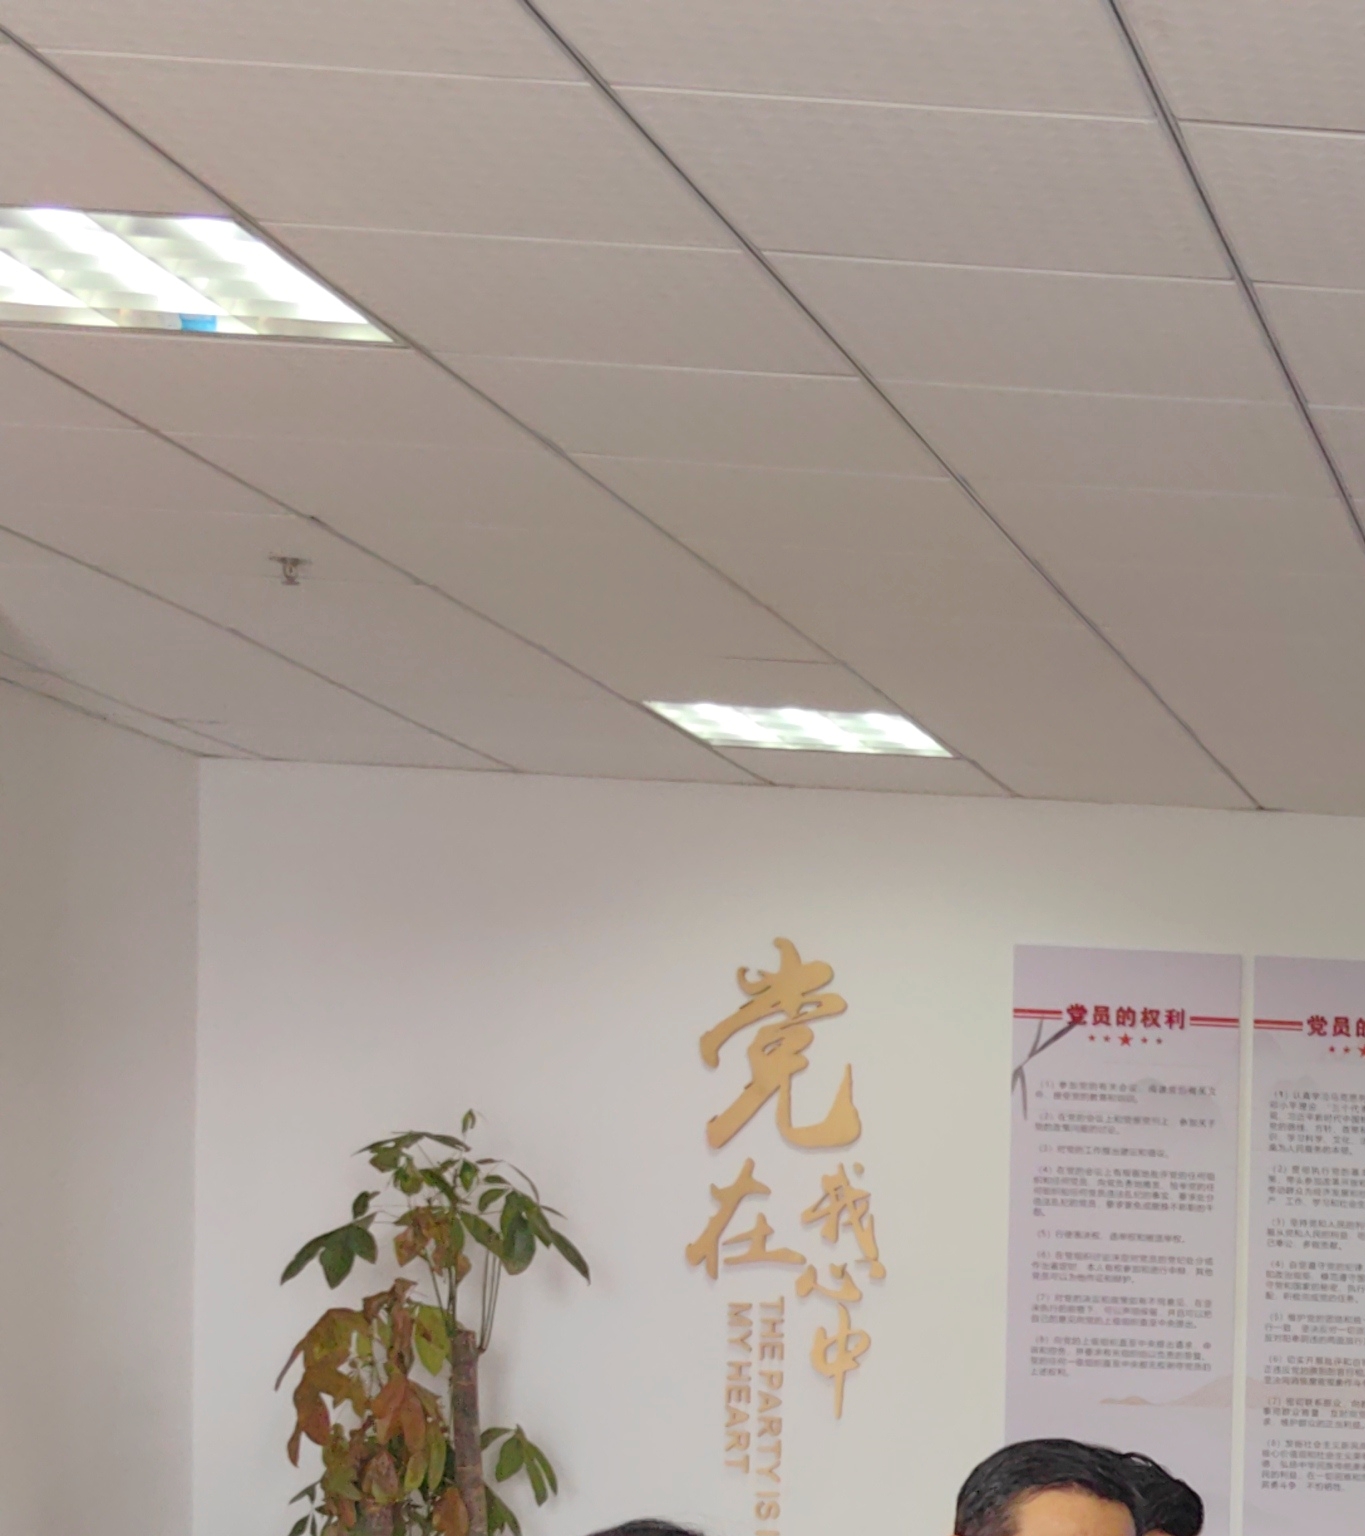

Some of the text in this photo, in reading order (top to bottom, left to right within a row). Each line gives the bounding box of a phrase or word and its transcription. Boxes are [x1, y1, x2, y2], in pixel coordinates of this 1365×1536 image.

[1066, 1003, 1186, 1030] 党员的权利
[759, 1296, 785, 1361] THE
[724, 1302, 753, 1474] MY HEART
[757, 1370, 784, 1483] PARTY
[755, 1491, 781, 1520] IS
